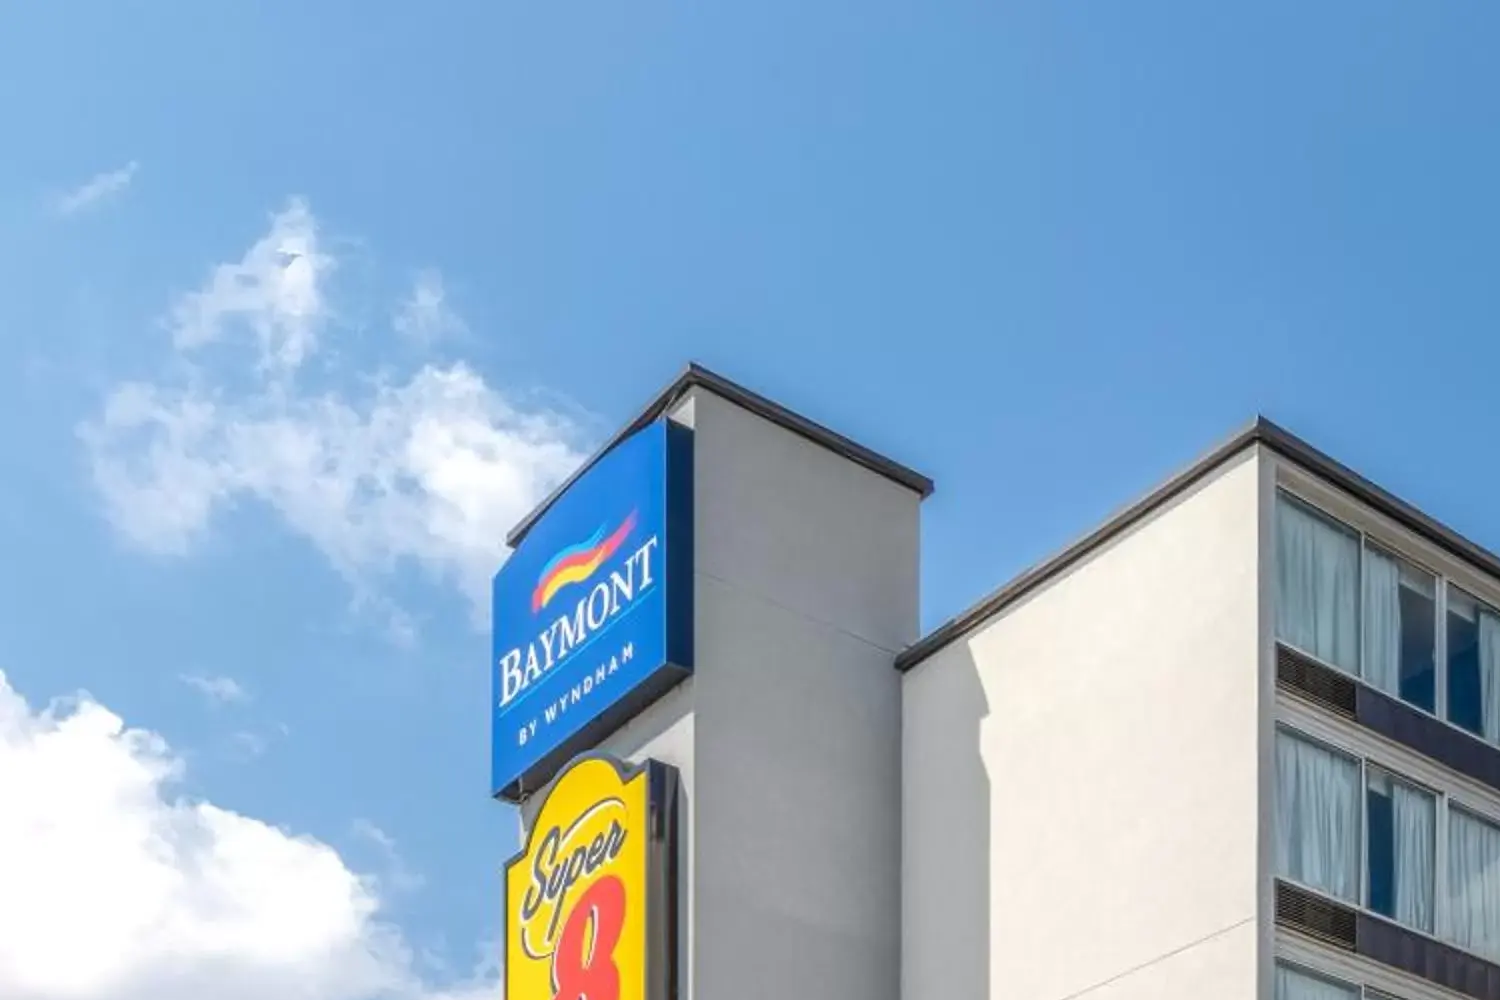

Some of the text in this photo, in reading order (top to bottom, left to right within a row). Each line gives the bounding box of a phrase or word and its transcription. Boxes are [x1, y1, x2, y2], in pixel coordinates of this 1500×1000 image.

[499, 535, 658, 708] BAYMONT
[519, 641, 635, 745] BY WYNDHAM
[521, 800, 628, 950] Super
